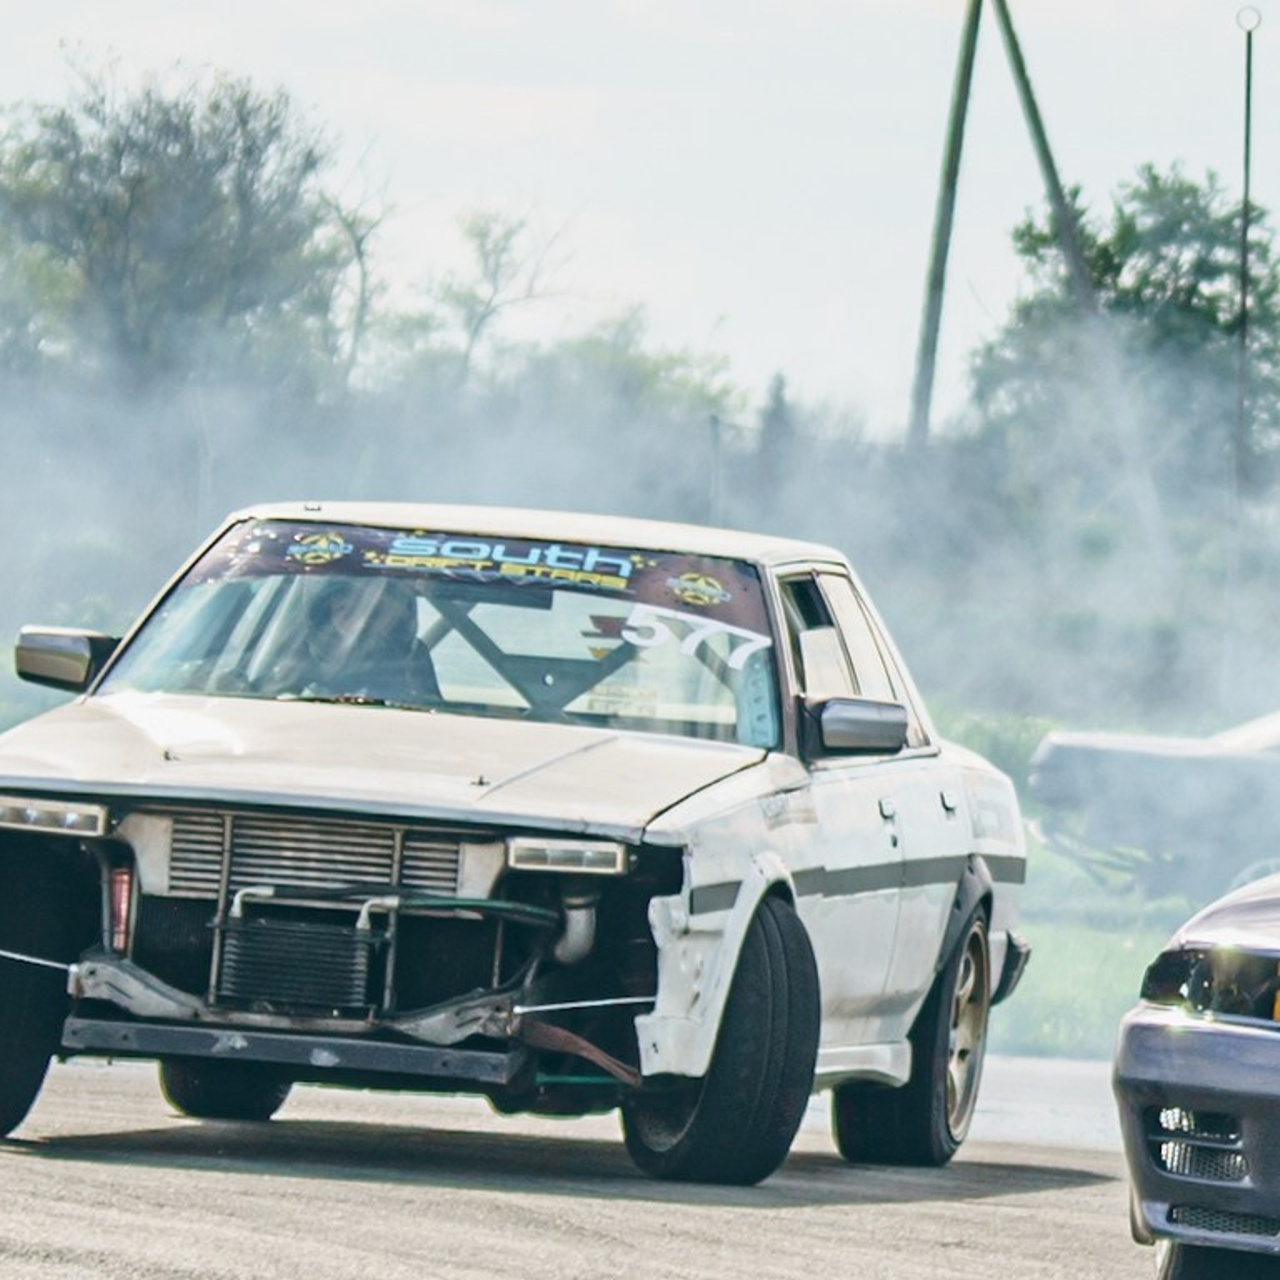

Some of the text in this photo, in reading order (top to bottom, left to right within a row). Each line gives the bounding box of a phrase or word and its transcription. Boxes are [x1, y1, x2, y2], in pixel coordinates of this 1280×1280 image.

[384, 554, 628, 589] DRIFT STARS
[621, 603, 772, 670] 577
